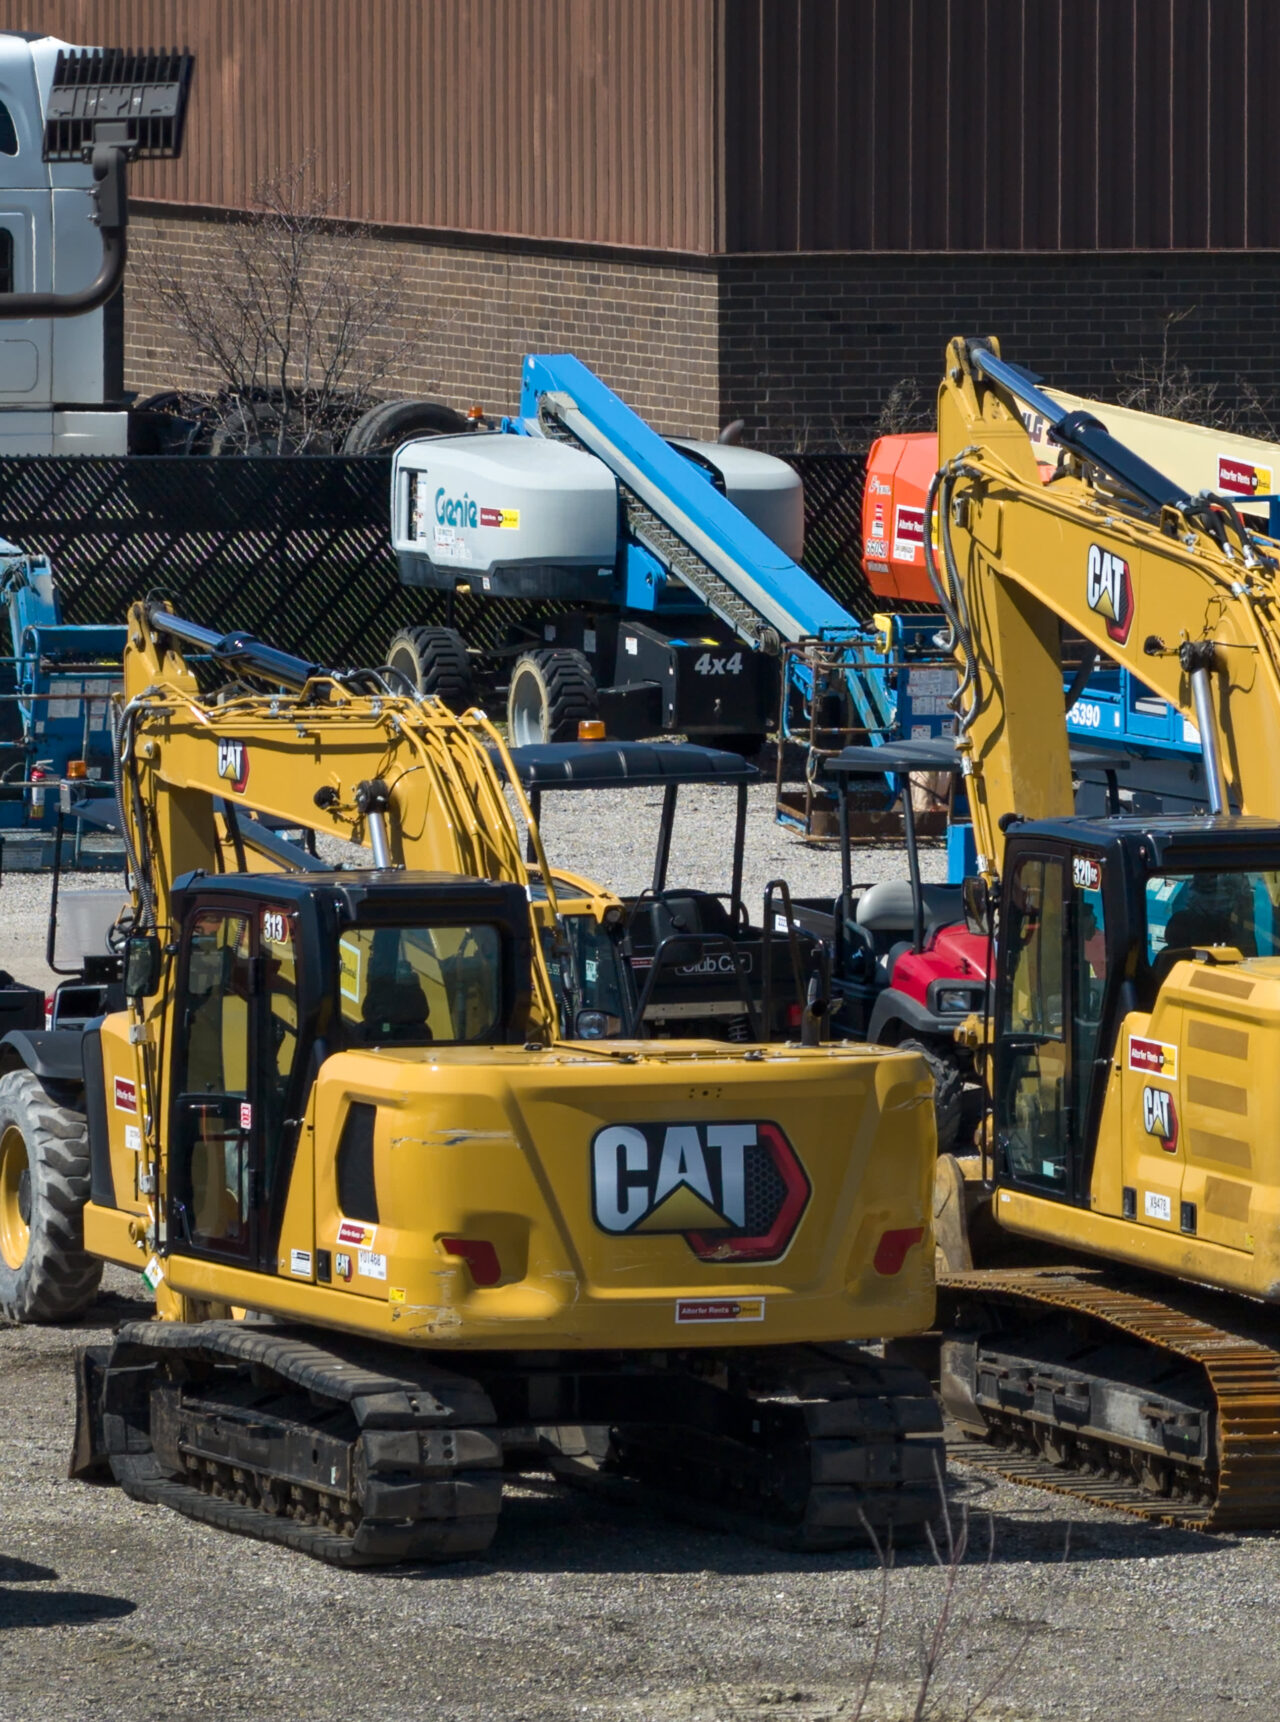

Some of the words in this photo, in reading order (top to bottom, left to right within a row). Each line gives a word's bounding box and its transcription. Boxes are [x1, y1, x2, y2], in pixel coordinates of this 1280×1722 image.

[435, 487, 477, 528] Genie
[1087, 544, 1125, 622] CAT
[694, 652, 743, 675] 4x4
[1065, 701, 1101, 728] -5390
[218, 737, 243, 780] CAT
[1073, 857, 1091, 887] 320
[264, 910, 283, 941] 313
[1144, 1087, 1170, 1138] CAT
[594, 1124, 758, 1232] CAT
[336, 1252, 350, 1277] CAT
[708, 1306, 730, 1314] Rents
